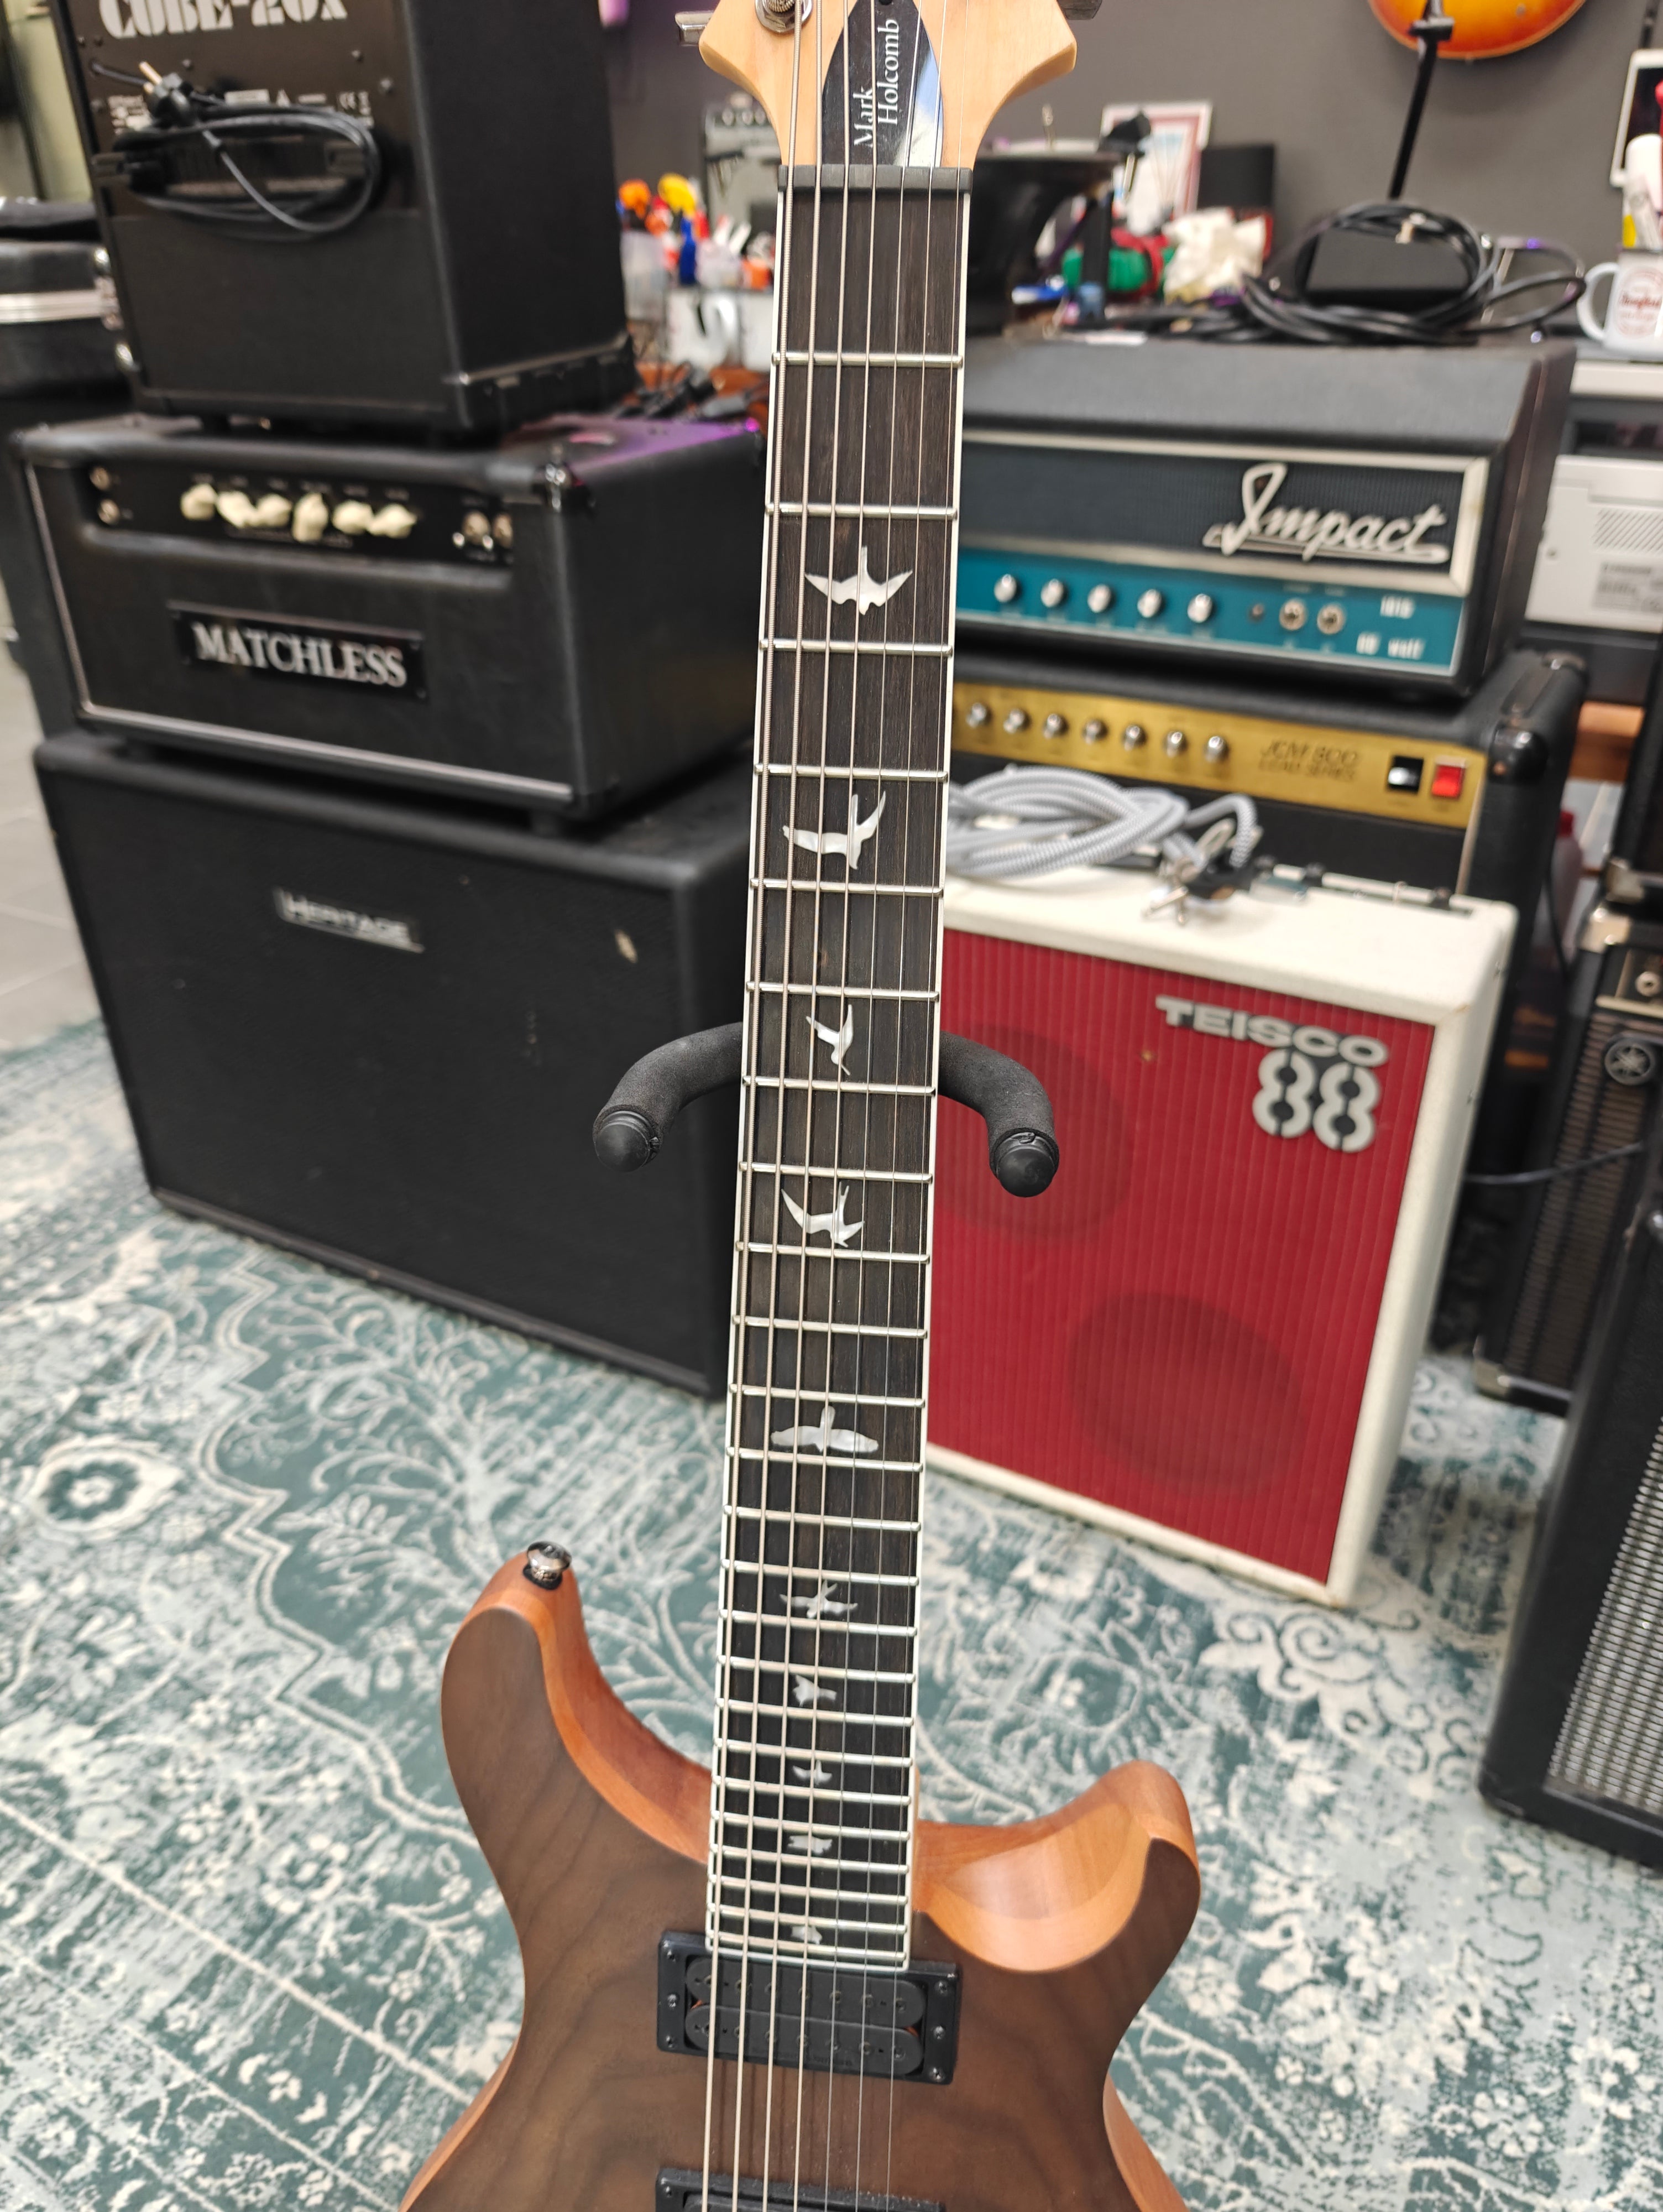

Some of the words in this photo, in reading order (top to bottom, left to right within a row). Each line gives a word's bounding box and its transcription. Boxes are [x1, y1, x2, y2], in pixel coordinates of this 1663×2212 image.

[876, 18, 900, 126] Holcomb
[853, 86, 875, 148] Mark
[1204, 462, 1449, 563] Impact
[191, 621, 407, 687] MATCHLESS
[1155, 994, 1389, 1068] TEISCO
[1252, 1049, 1380, 1154] 88
